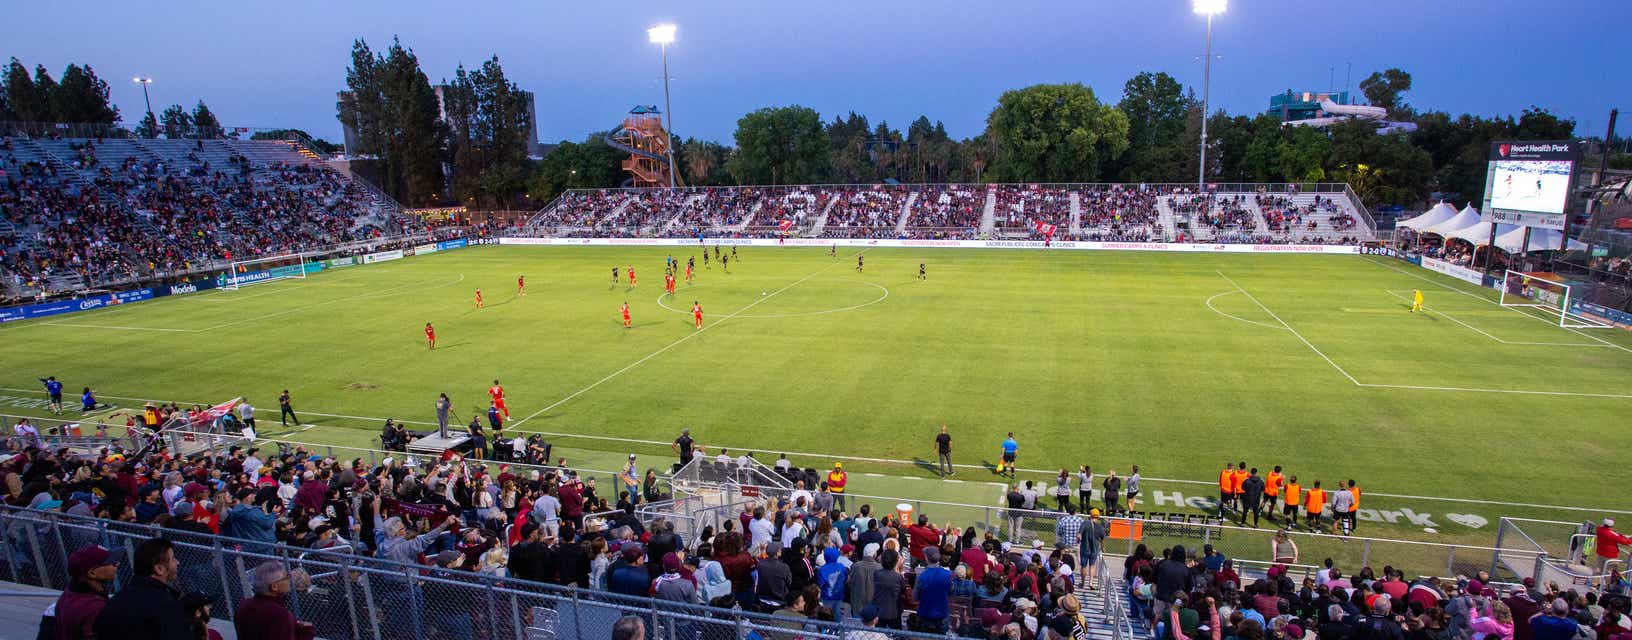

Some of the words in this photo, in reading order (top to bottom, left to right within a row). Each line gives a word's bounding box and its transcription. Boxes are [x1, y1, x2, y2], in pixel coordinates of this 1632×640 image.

[1510, 144, 1529, 152] Heart
[1529, 144, 1551, 152] Health
[1551, 144, 1569, 152] Park
[1494, 212, 1506, 221] 988
[1369, 247, 1379, 255] 2-0
[245, 271, 270, 281] HEALTH
[170, 283, 197, 295] Modelo
